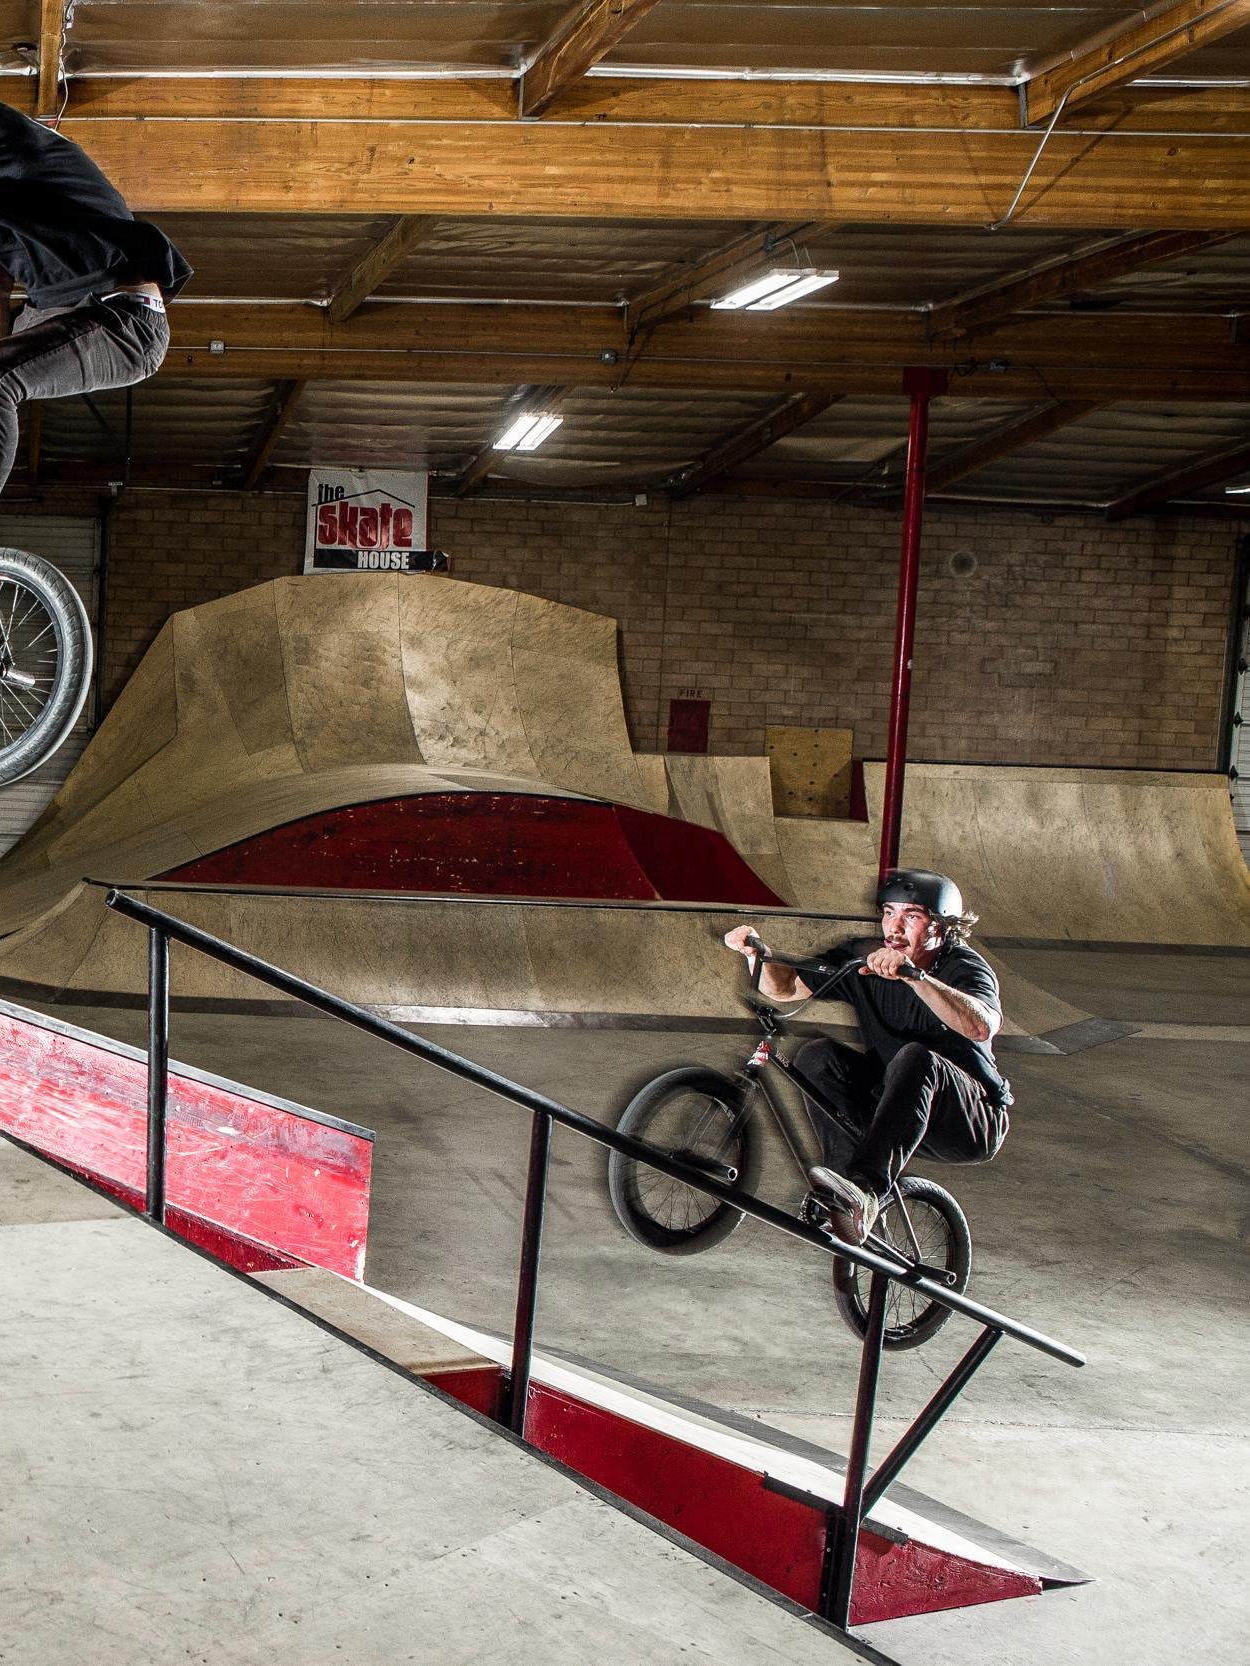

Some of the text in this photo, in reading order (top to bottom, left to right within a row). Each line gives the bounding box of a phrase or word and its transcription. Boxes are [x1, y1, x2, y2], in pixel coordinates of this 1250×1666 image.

[318, 484, 345, 502] the
[318, 501, 412, 550] skate
[357, 551, 410, 570] HOUSE
[679, 689, 703, 698] FIRE
